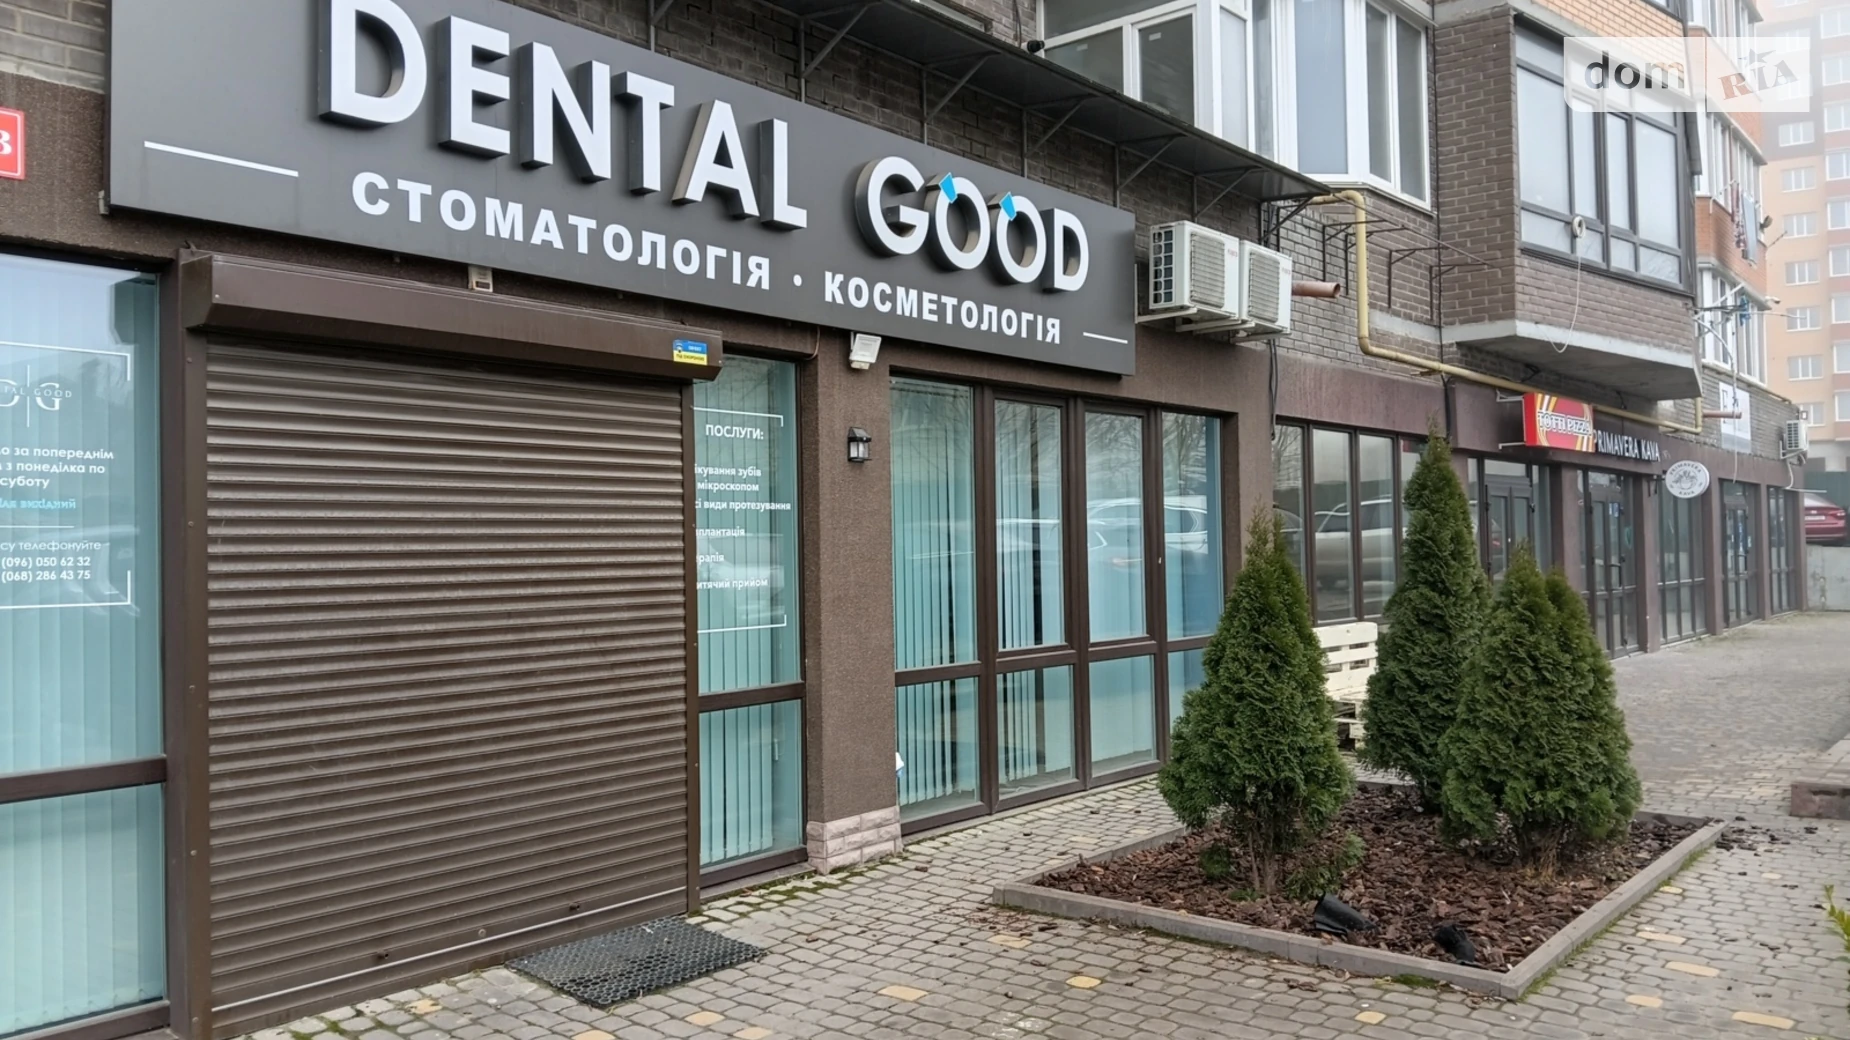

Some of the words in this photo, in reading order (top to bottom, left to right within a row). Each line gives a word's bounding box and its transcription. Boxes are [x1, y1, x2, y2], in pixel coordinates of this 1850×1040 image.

[319, 0, 808, 232] DENTAL
[855, 156, 1089, 292] GOOD
[351, 172, 770, 291] СТОМАТОЛОГІЯ
[824, 271, 1061, 344] КОСМЕТОЛОГІЯ
[34, 388, 73, 399] GOOD
[705, 424, 764, 440] ПОСЛУГИ:
[1593, 428, 1640, 459] PRIMAVERA
[1641, 439, 1661, 462] KAVA
[14, 447, 29, 456] за
[33, 448, 114, 460] попереднім
[16, 462, 85, 474] понеділка
[89, 465, 105, 473] по
[0, 476, 50, 489] суботу
[697, 480, 760, 493] мікроскопом
[703, 501, 727, 510] види
[729, 501, 791, 512] протезування
[19, 540, 102, 552] телефонуйте
[1, 556, 32, 569] (096)
[36, 556, 57, 567] 050
[60, 556, 74, 567] 62
[77, 556, 91, 566] 32
[1, 570, 32, 583] (068)
[36, 570, 57, 581] 286
[60, 570, 74, 580] 43
[77, 570, 91, 579] 75
[732, 578, 768, 590] прийом
